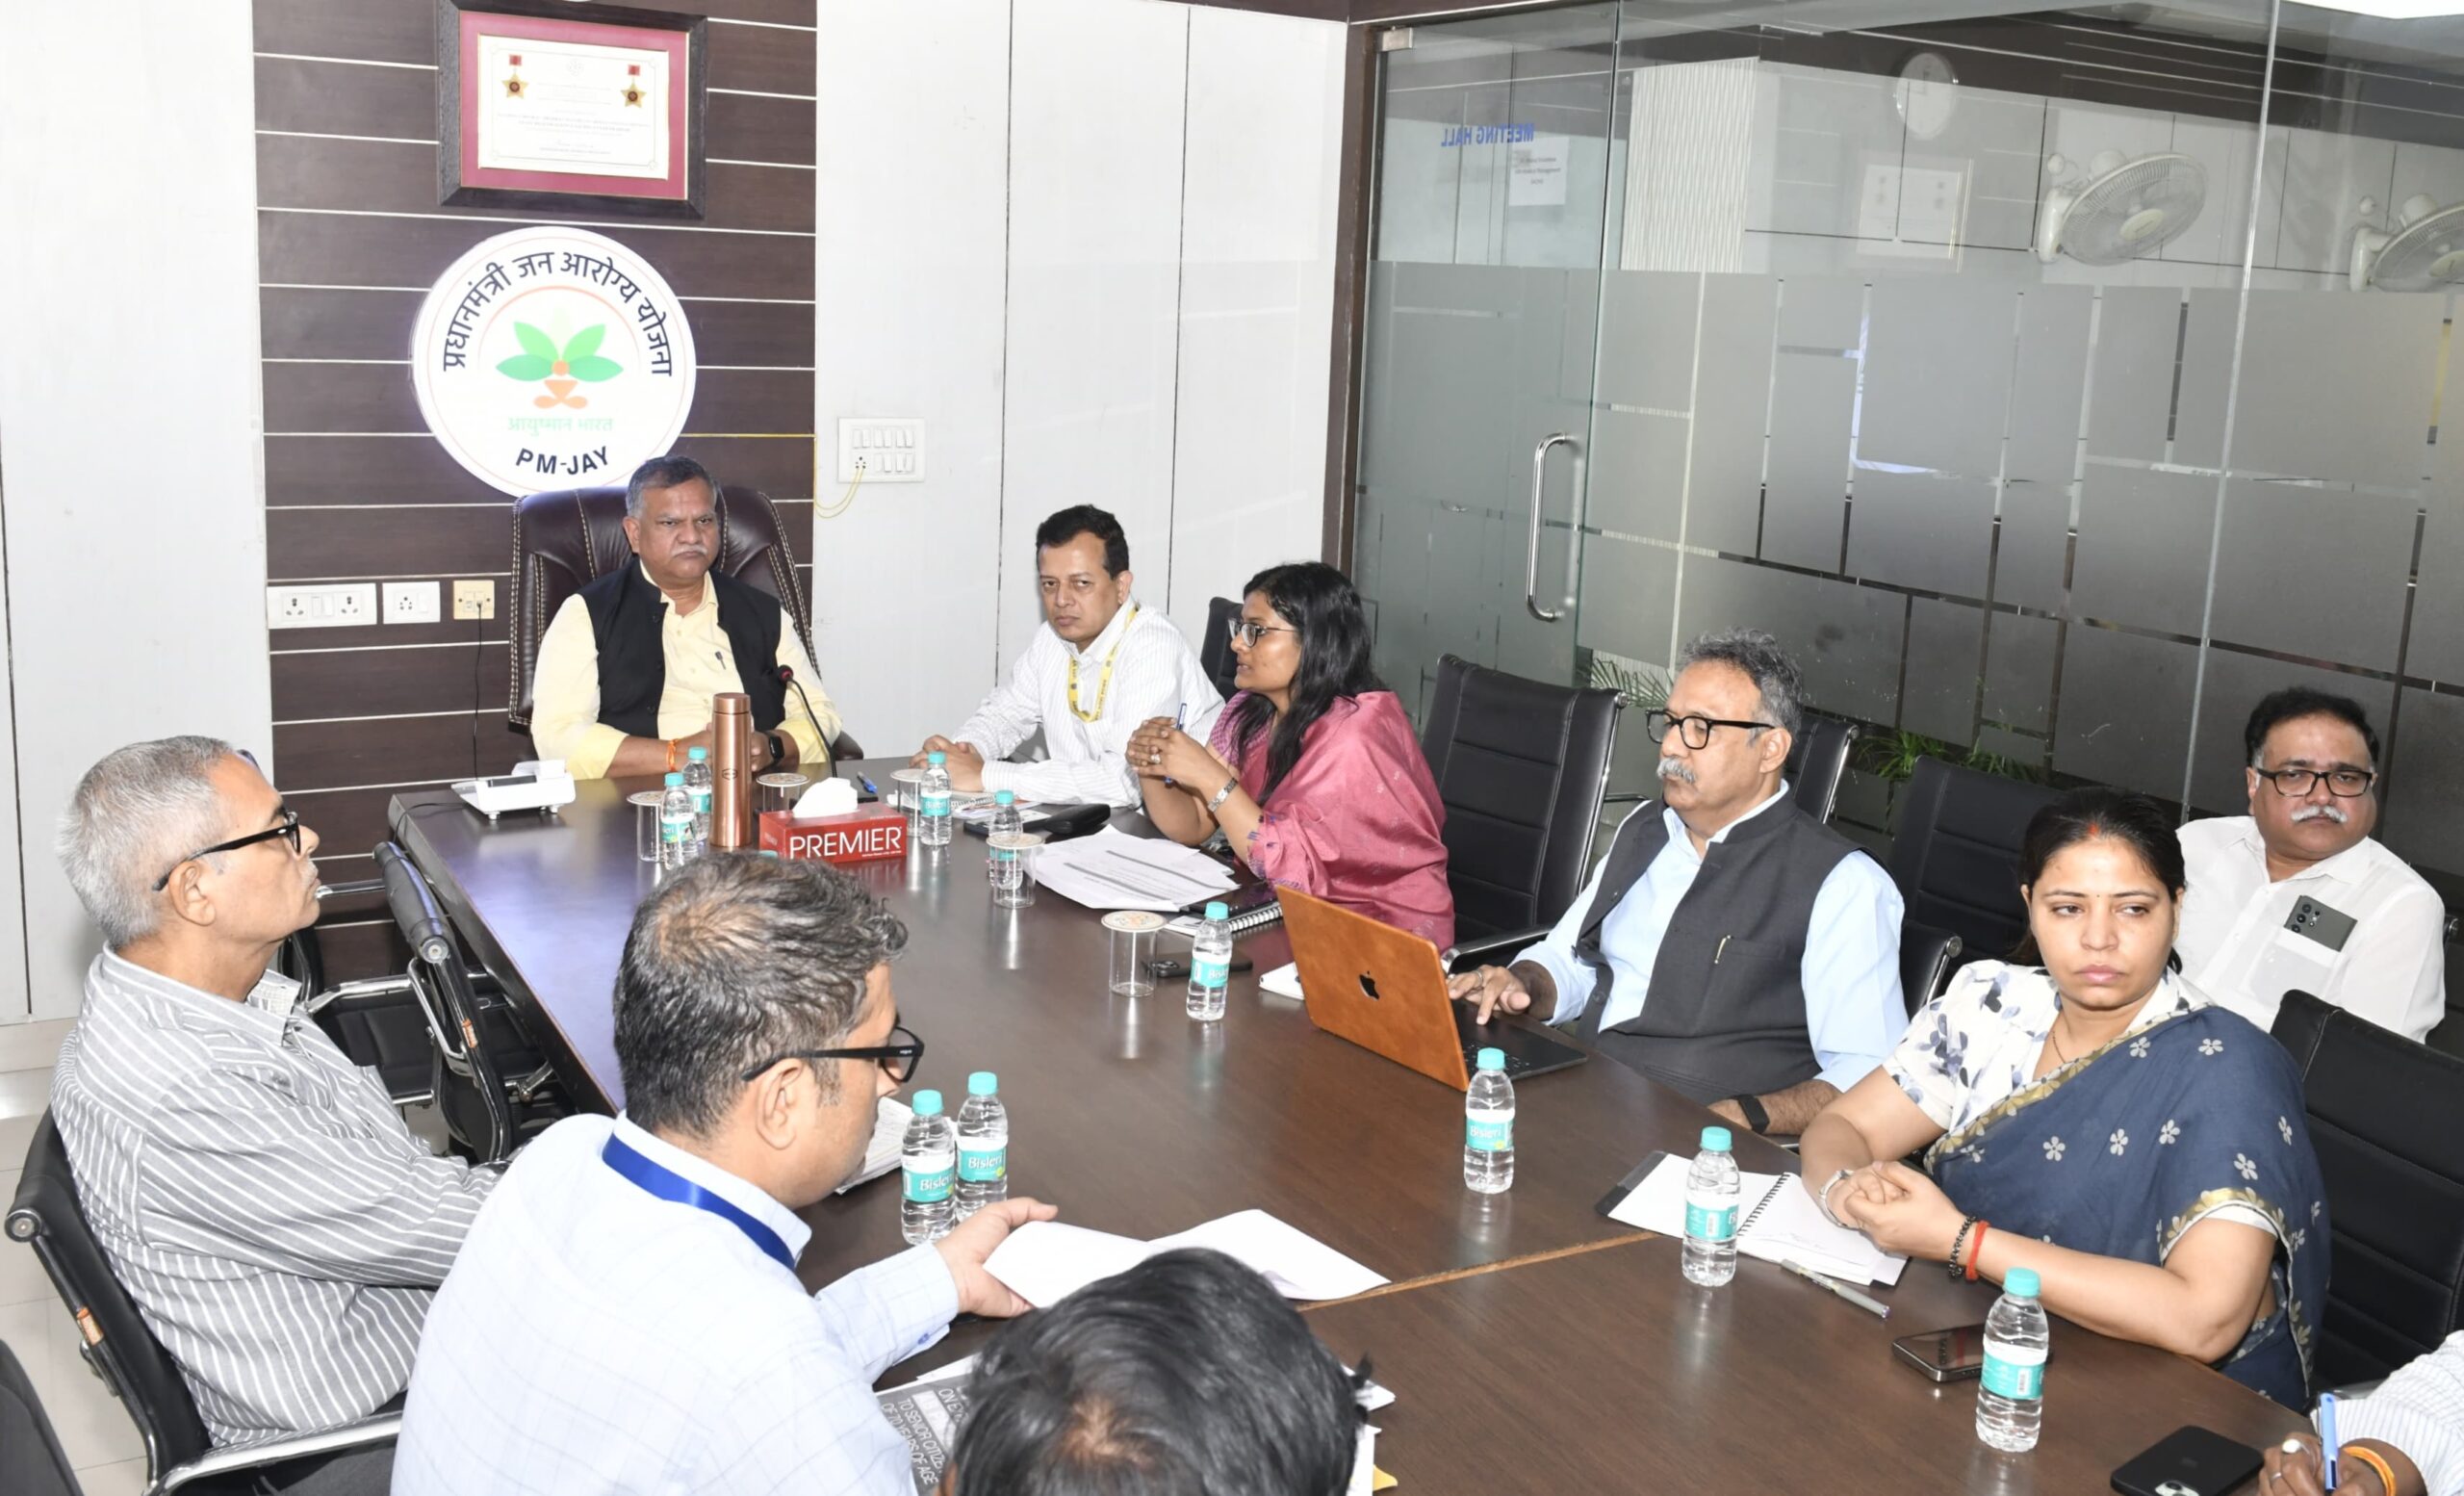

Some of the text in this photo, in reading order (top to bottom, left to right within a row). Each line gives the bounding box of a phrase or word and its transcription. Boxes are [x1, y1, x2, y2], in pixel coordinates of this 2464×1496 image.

[443, 251, 673, 377] प्रधानमंत्री जन आरोग्य योजना
[508, 416, 614, 437] आयुष्मान भारत
[516, 446, 609, 475] PM-JAY
[789, 827, 902, 860] PREMIER
[968, 1154, 1003, 1170] Bisleri
[881, 1403, 897, 1416] OF
[898, 1398, 914, 1411] TO
[905, 1410, 933, 1440] SENIOR
[911, 1452, 928, 1466] OF
[922, 1440, 946, 1474] CITIZE
[917, 1466, 939, 1485] AGE
